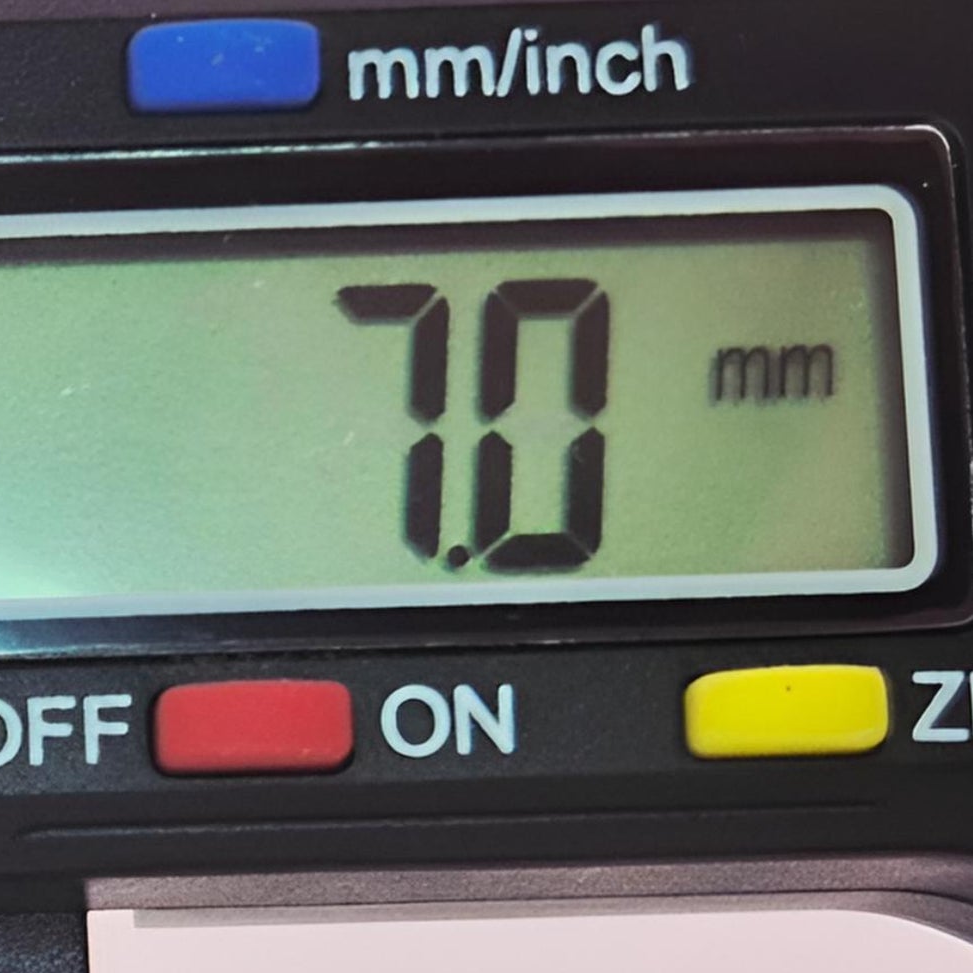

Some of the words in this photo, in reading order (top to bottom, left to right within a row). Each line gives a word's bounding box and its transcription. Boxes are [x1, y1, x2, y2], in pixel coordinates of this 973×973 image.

[347, 24, 690, 101] mm/inch
[334, 277, 610, 575] 7.0
[713, 342, 836, 406] mm
[380, 684, 516, 756] ON
[911, 670, 973, 742] Z
